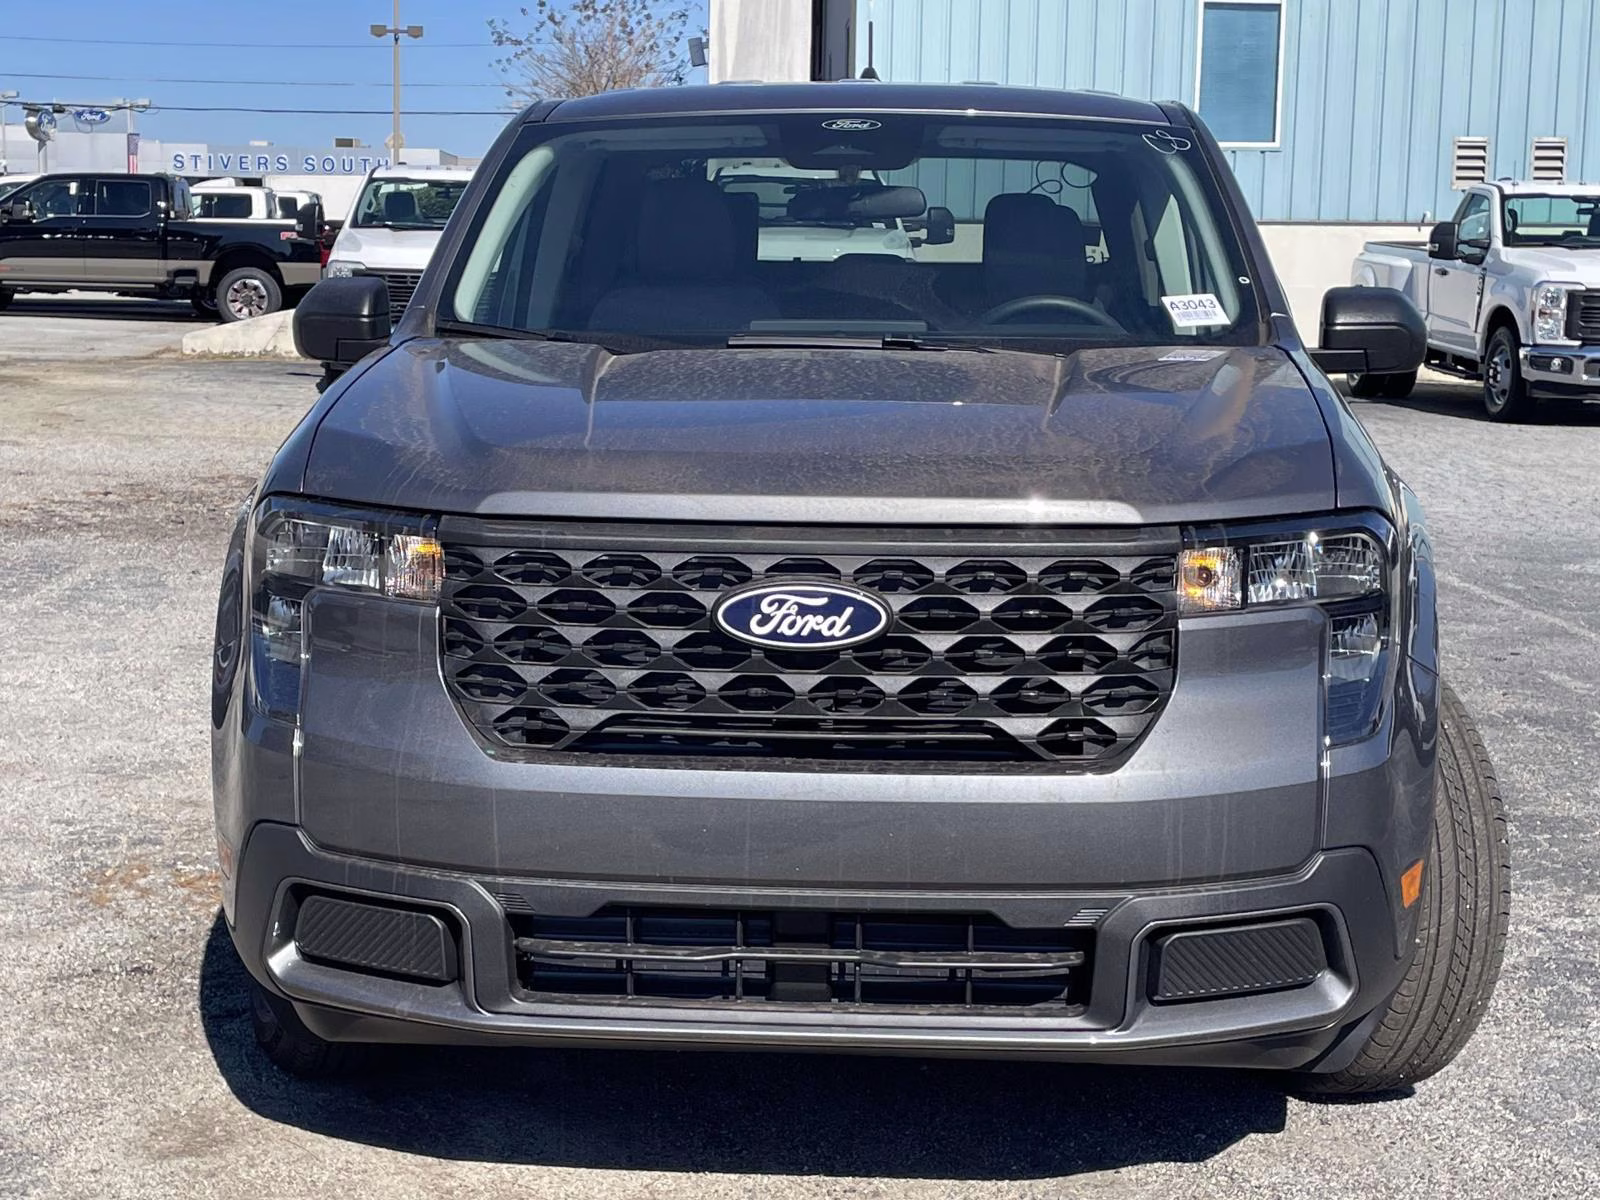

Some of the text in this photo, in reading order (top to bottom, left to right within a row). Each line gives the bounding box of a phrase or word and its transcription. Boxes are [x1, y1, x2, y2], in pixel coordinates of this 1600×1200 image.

[832, 120, 870, 129] Ford
[173, 154, 288, 171] STIVERS
[1169, 299, 1216, 311] A3043
[750, 594, 854, 637] Ford
